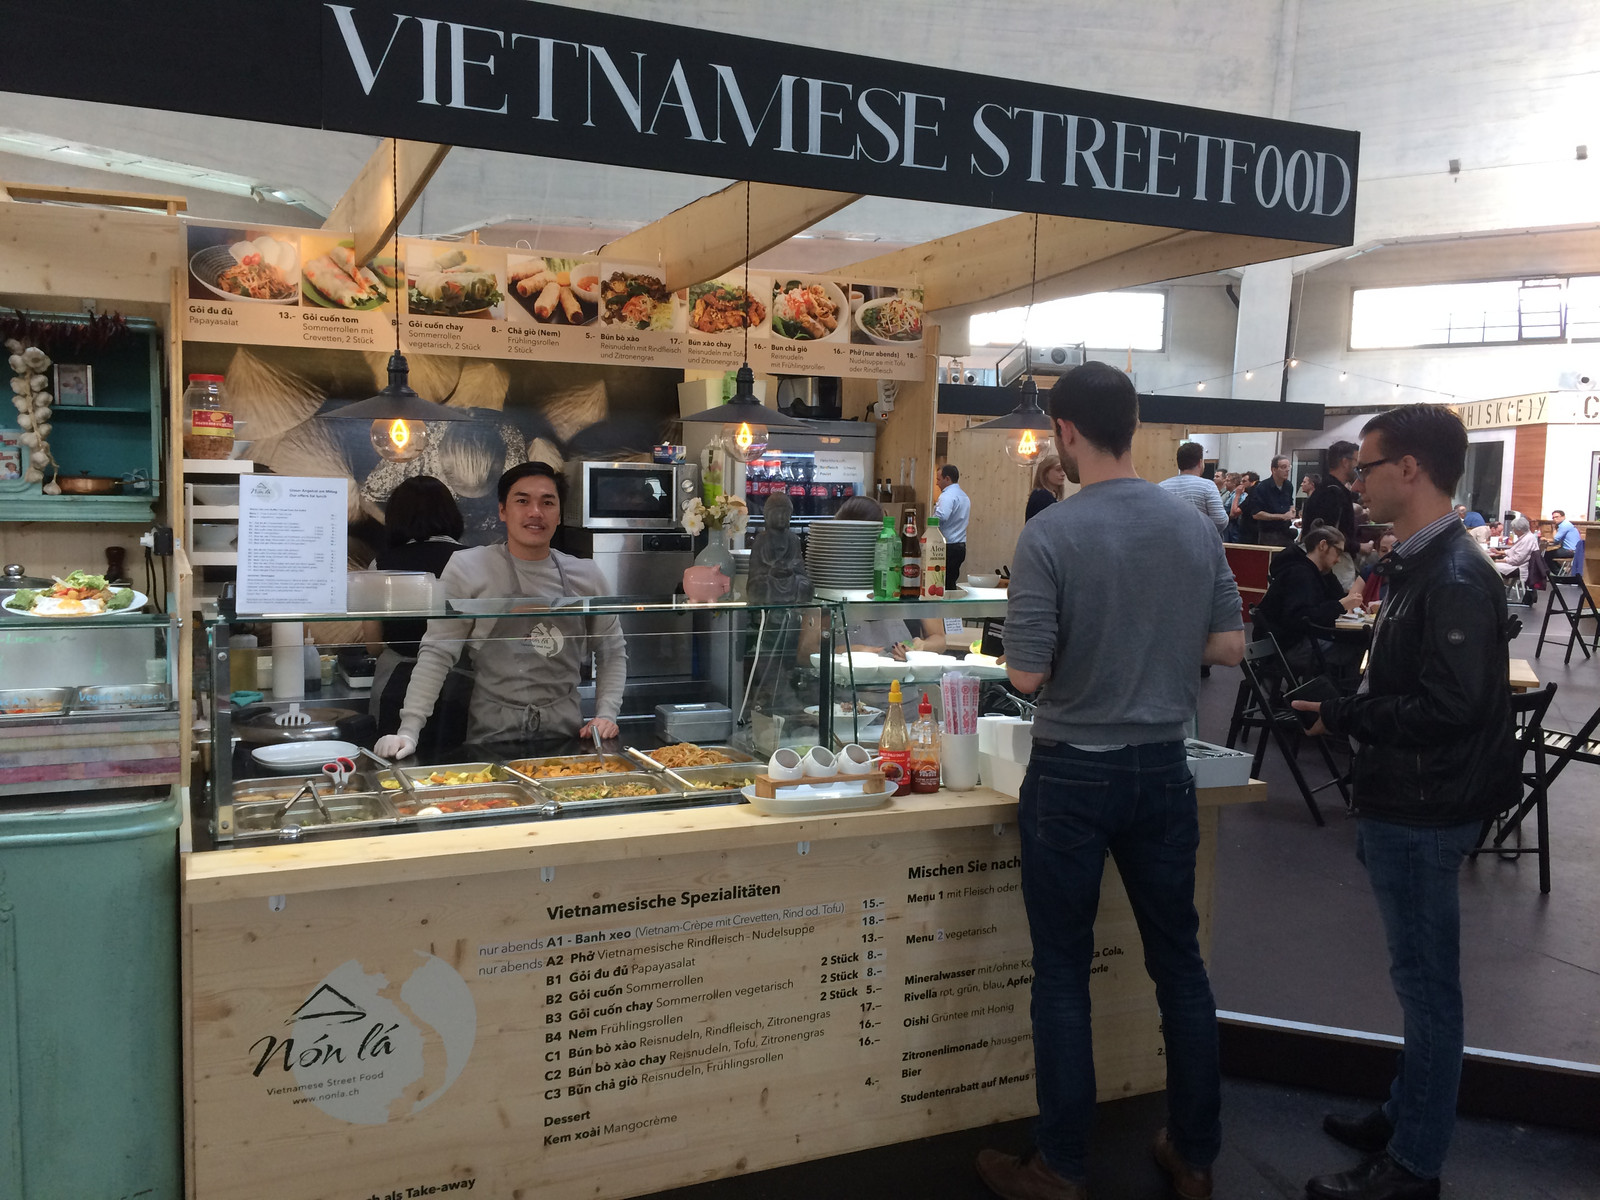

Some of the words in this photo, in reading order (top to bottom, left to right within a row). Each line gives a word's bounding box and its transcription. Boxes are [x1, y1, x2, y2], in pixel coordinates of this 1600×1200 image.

[323, 3, 947, 171] VIETNAMESE
[971, 103, 1351, 217] STREETFOOD
[189, 315, 238, 326] Papayasalat
[279, 312, 296, 320] 13.-
[303, 323, 358, 334] Sommerrollen
[408, 330, 461, 340] Sommerrollen
[446, 323, 464, 332] chay
[538, 329, 560, 338] (Nem)
[303, 333, 344, 344] Crevetten,
[353, 336, 374, 344] Stück
[408, 340, 453, 350] vegetarisch,
[462, 342, 480, 350] Stück
[508, 337, 560, 346] Frühlingsrollen
[600, 342, 636, 350] Reisnudeln
[648, 345, 682, 354] Rindfleisch
[716, 341, 732, 349] chay
[614, 352, 654, 362] Zitronengras
[701, 358, 738, 366] Zitronengras
[849, 358, 884, 366] Nudelsuppe
[876, 350, 900, 358] abends)
[782, 362, 825, 371] Frühlingsrollen
[908, 864, 964, 880] Mischen
[968, 860, 988, 873] Sie
[990, 856, 1020, 870] nach
[546, 894, 676, 920] Vietnamesische
[680, 884, 781, 908] Spezialitäten
[907, 892, 936, 904] Menu
[938, 891, 944, 900] 1
[946, 889, 961, 898] mit
[964, 884, 995, 897] Fleisch
[997, 882, 1018, 894] oder
[480, 946, 499, 956] nur
[501, 938, 544, 954] abends
[546, 936, 562, 948] A1
[575, 931, 606, 944] Banh
[610, 931, 632, 941] xeo
[635, 920, 714, 939] (Vietnam-Crèpe
[716, 916, 731, 928] mit
[732, 912, 780, 926] Crevetten,
[782, 907, 804, 919] Rind
[806, 906, 821, 917] od.
[822, 902, 845, 914] Tofu)
[906, 934, 934, 944] Menu
[937, 930, 944, 940] 2
[945, 924, 997, 940] vegetarisch
[478, 966, 498, 976] nur
[500, 958, 543, 974] abends
[546, 955, 564, 967] A2
[598, 939, 684, 960] Vietnamesische
[687, 932, 744, 948] Rindfleisch
[752, 924, 815, 940] Nudelsuppe
[546, 974, 562, 986] B1
[569, 970, 590, 982] Gỏi
[594, 968, 610, 980] đu
[632, 957, 696, 975] Papayasalat
[904, 968, 976, 986] Mineralwasser
[978, 961, 1020, 976] mit/ohne
[1102, 946, 1124, 957] Cola,
[546, 994, 562, 1005] B2
[569, 989, 590, 1002] Gỏi
[594, 984, 622, 998] cuốn
[626, 975, 704, 994] Sommerrollen
[820, 956, 828, 966] 2
[830, 952, 859, 965] Stück
[545, 1012, 562, 1024] B3
[568, 1008, 590, 1020] Gỏi
[594, 1003, 622, 1016] cuốn
[626, 1000, 654, 1013] chay
[656, 989, 732, 1008] Sommerrollen
[734, 978, 794, 998] vegetarisch
[820, 974, 828, 984] 2
[830, 970, 858, 983] Stück
[904, 988, 938, 1002] Rivella
[940, 987, 955, 997] rot,
[956, 984, 980, 996] grün,
[982, 980, 1005, 990] blau,
[545, 1032, 562, 1043] B4
[568, 1028, 598, 1040] Nem
[600, 1014, 684, 1035] Frühlingsrollen
[820, 991, 827, 1001] 2
[830, 987, 858, 1000] Stück
[903, 1015, 929, 1028] Oishi
[931, 1010, 968, 1024] Grüntee
[970, 1008, 986, 1017] mit
[987, 1004, 1014, 1014] Honig
[544, 1050, 561, 1062] C1
[568, 1047, 592, 1059] Bún
[596, 1042, 612, 1054] bò
[614, 1039, 637, 1052] xào
[640, 1030, 702, 1047] Reisnudeln,
[706, 1020, 764, 1036] Rindfleisch,
[767, 1010, 831, 1027] Zitronengras
[248, 1034, 346, 1077] Nón
[356, 1022, 400, 1061] lá
[544, 1070, 562, 1082] C2
[568, 1066, 592, 1078] Bún
[595, 1062, 611, 1073] bò
[614, 1058, 636, 1070] xào
[639, 1054, 667, 1066] chay
[669, 1044, 731, 1061] Reisnudeln,
[734, 1038, 758, 1051] Tofu,
[760, 1028, 825, 1046] Zitronengras
[902, 1038, 989, 1062] Zitronenlimonade
[266, 1081, 324, 1096] Vietnamese
[326, 1076, 356, 1087] Street
[360, 1071, 384, 1082] Food
[544, 1088, 562, 1100] C3
[594, 1078, 616, 1092] chả
[618, 1076, 638, 1091] giò
[641, 1065, 704, 1084] Reisnudeln,
[706, 1052, 784, 1072] Frühlingsrollen
[902, 1068, 922, 1078] Bier
[292, 1088, 360, 1105] www.nonla.ch
[900, 1082, 980, 1104] Studentenrabatt
[981, 1078, 996, 1089] auf
[998, 1072, 1030, 1086] Menus
[544, 1110, 591, 1127] Dessert
[543, 1134, 572, 1146] Kem
[574, 1126, 600, 1141] xoài
[604, 1114, 678, 1136] Mangocrème
[406, 1178, 476, 1198] Take-away
